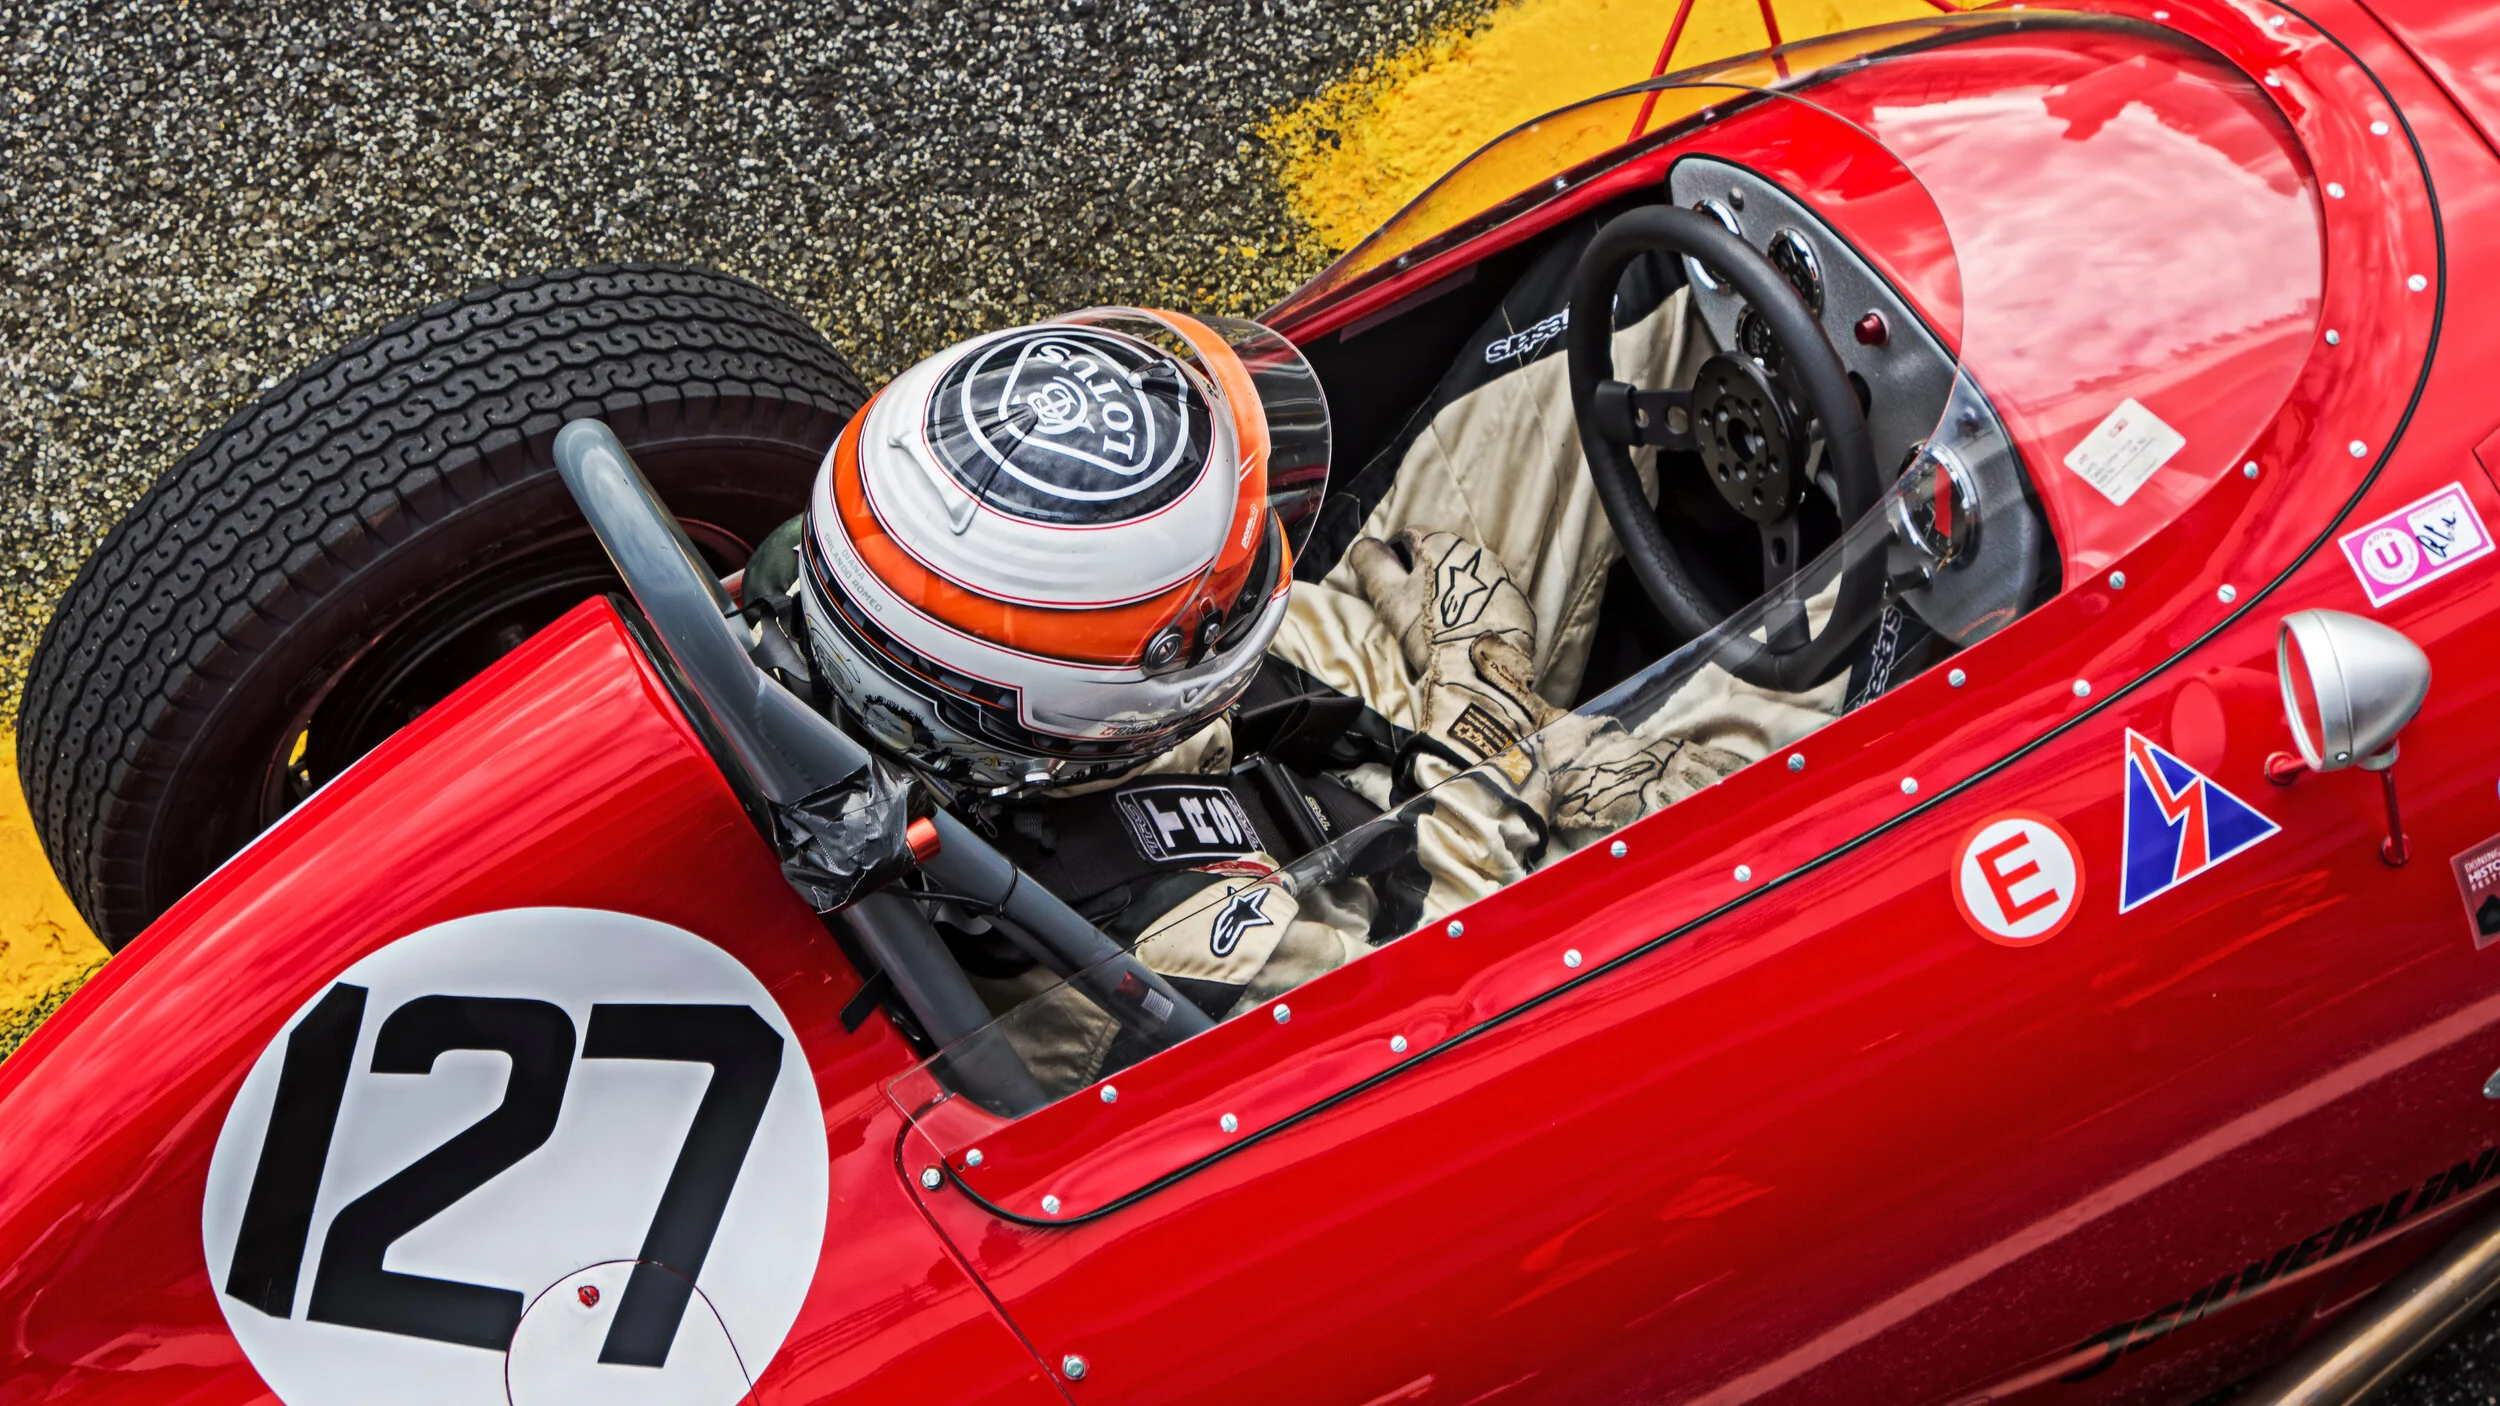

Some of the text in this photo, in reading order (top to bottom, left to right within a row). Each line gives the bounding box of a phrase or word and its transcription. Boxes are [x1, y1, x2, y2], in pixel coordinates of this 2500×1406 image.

[1037, 344, 1136, 461] LOTUS
[824, 533, 883, 613] ORLANDO ROMEO
[842, 548, 865, 581] DIANA
[2375, 541, 2403, 569] U
[1143, 796, 1242, 848] TRS
[1976, 831, 2060, 926] E
[2468, 859, 2500, 884] HISTO
[225, 981, 786, 1368] 127
